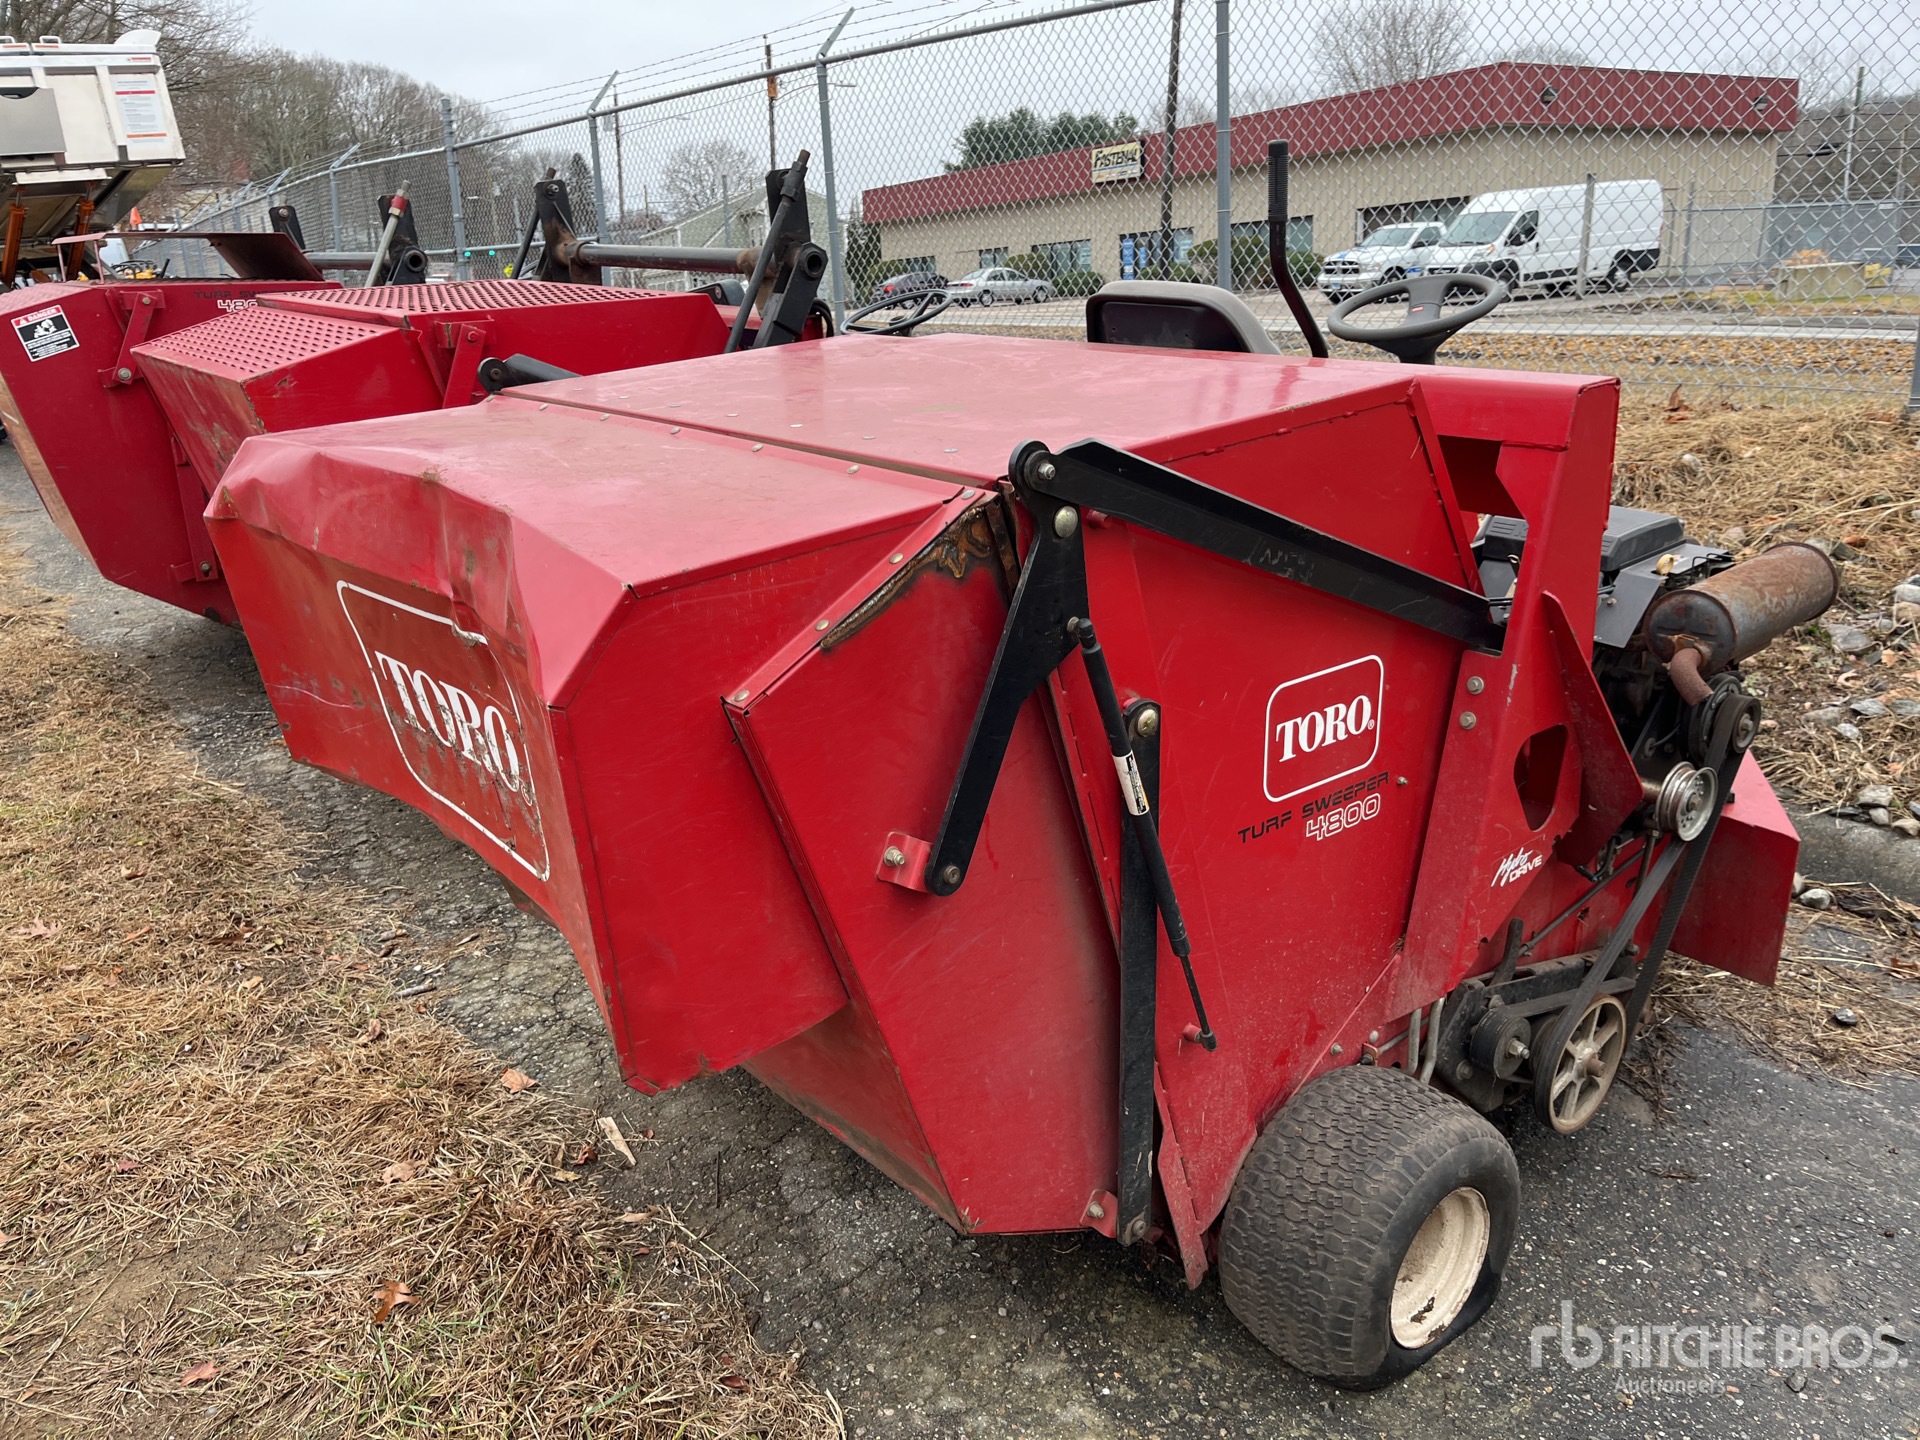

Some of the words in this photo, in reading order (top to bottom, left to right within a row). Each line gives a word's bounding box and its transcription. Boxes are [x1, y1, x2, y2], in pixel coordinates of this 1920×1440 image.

[374, 650, 520, 792] TORO
[1275, 694, 1372, 763] TORO
[1237, 809, 1293, 844] TURF
[1301, 771, 1389, 819] SWEEPER
[1305, 792, 1382, 842] 4800
[1508, 854, 1543, 883] DRIVE
